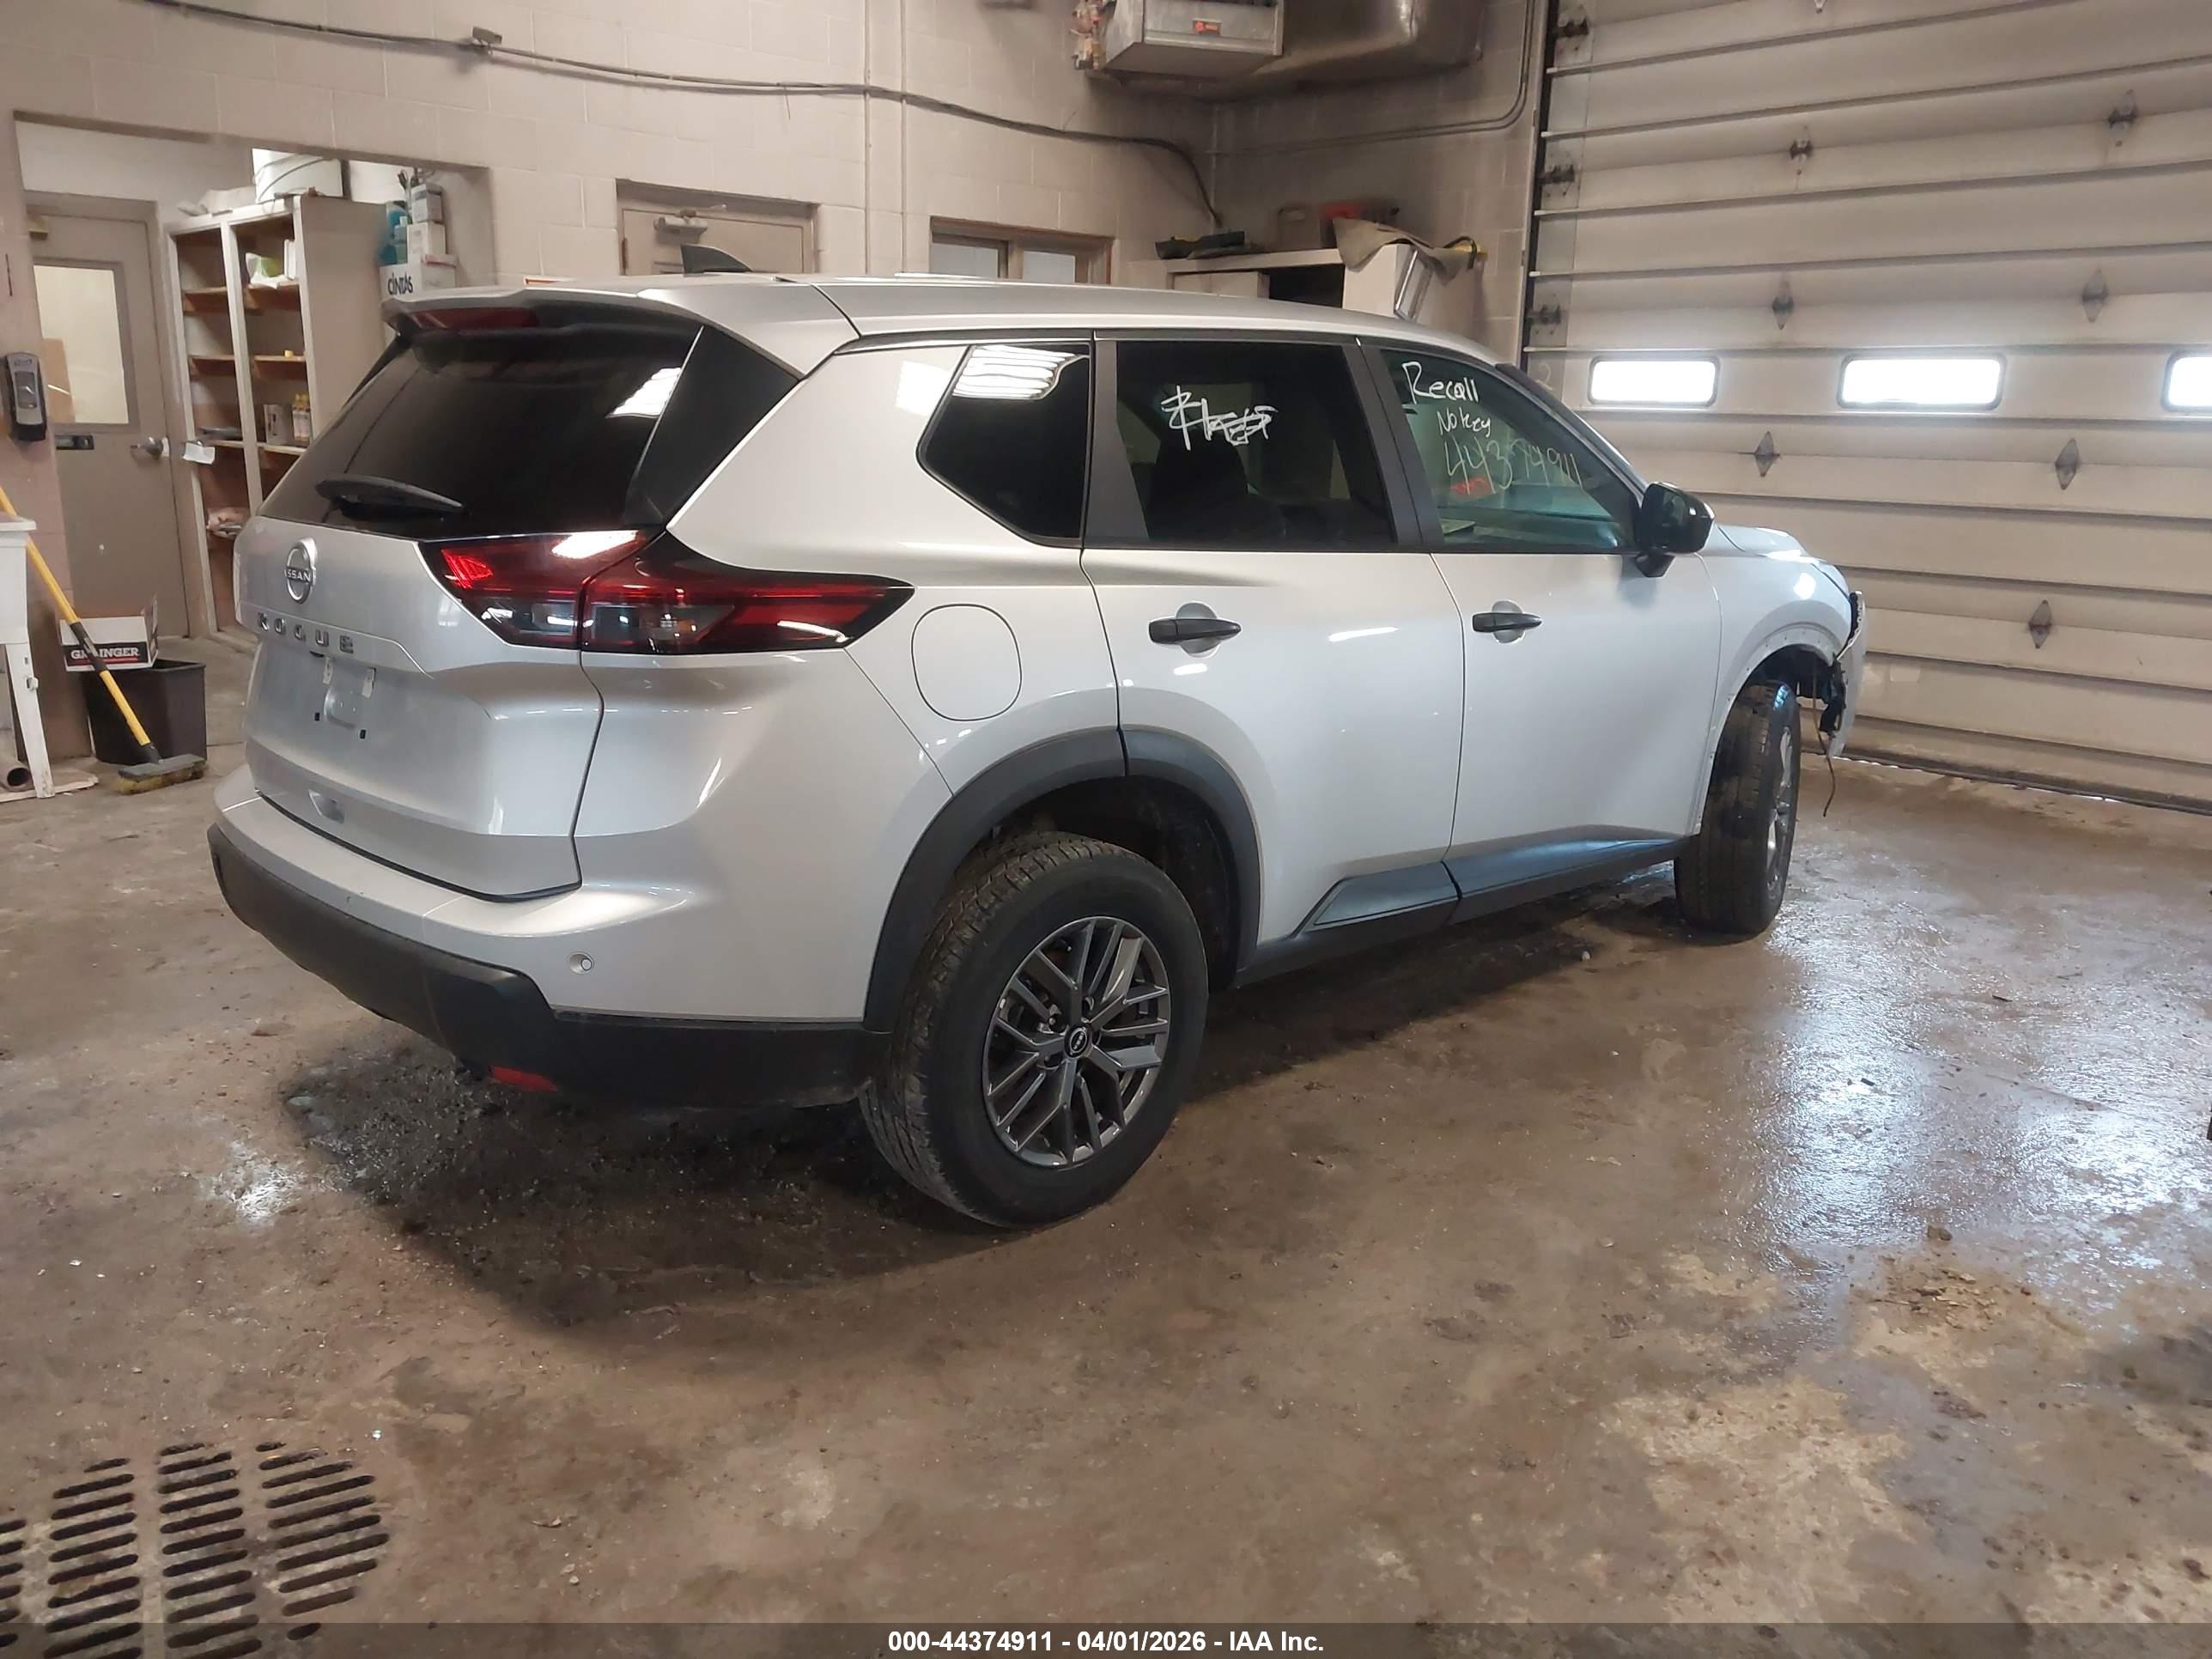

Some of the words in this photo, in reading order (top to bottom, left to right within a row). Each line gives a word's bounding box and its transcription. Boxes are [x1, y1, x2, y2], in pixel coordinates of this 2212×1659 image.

[387, 271, 414, 295] CINTAS
[1401, 361, 1480, 405] Recall
[1443, 432, 1584, 495] 44374911
[70, 647, 140, 660] GRINGER
